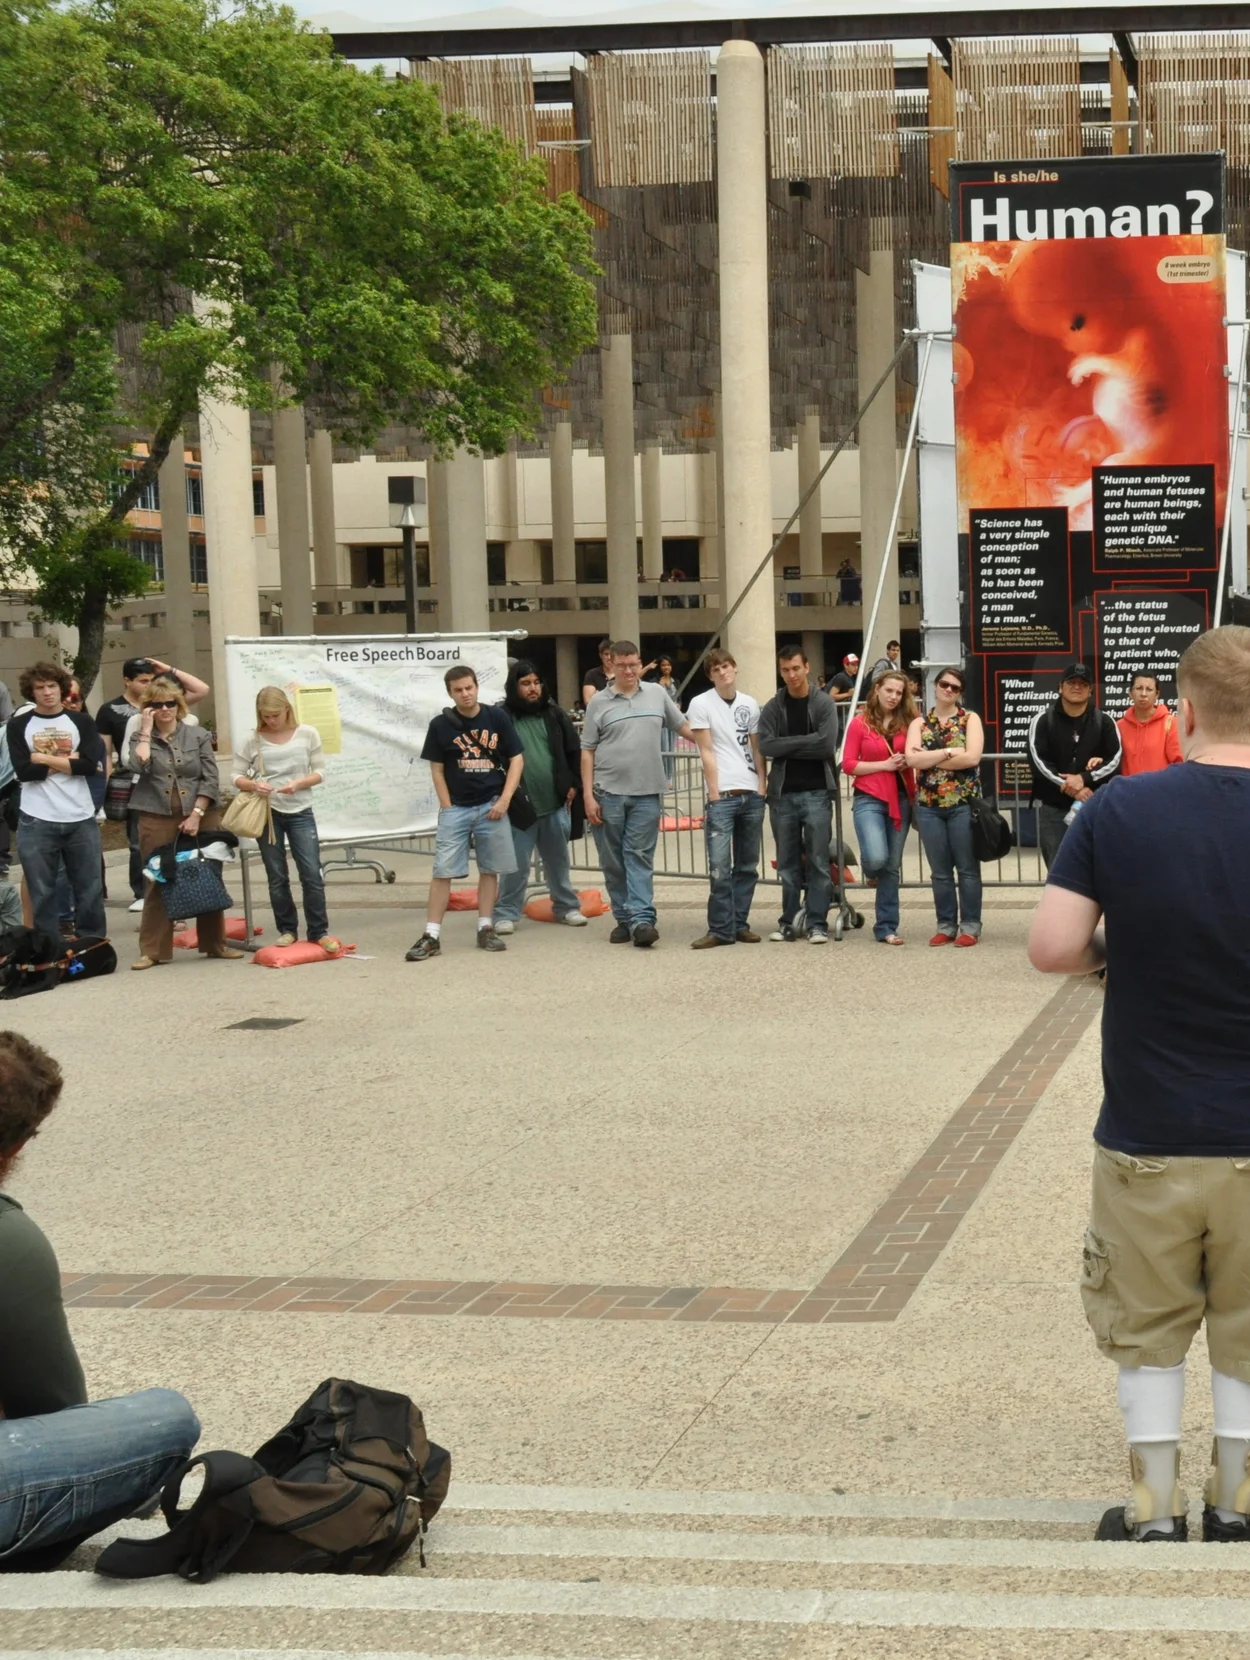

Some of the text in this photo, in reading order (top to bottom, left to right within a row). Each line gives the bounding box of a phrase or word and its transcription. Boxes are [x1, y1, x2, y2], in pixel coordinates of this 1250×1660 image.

[993, 169, 1059, 183] Is she/he
[970, 189, 1215, 242] Human?
[1188, 261, 1211, 269] embryo
[1144, 474, 1191, 485] embryos
[1104, 486, 1206, 497] and human fetuses
[1104, 498, 1202, 509] are human beings,
[1104, 510, 1186, 521] each with their
[1024, 518, 1043, 527] has
[1104, 523, 1168, 534] own unique
[980, 530, 1050, 541] a very simple
[1105, 536, 1145, 547] genetic
[980, 542, 1039, 553] conception
[980, 554, 1021, 564] of man;
[980, 568, 993, 576] as
[1023, 567, 1036, 575] as
[981, 578, 1044, 588] he has been
[981, 590, 1038, 600] conceived,
[981, 604, 988, 612] a
[1134, 600, 1168, 609] status
[982, 614, 991, 624] is
[1103, 612, 1166, 622] of the fetus
[1103, 624, 1200, 634] has been elevated
[1104, 636, 1156, 646] to that of
[326, 646, 460, 664] Free Speech Board
[1113, 649, 1152, 660] patient
[1154, 648, 1180, 658] who,
[1104, 661, 1115, 670] in
[1117, 661, 1145, 672] large
[1104, 674, 1124, 682] can
[1105, 685, 1123, 694] the
[1004, 691, 1060, 700] fertilizatio
[1004, 703, 1014, 713] is
